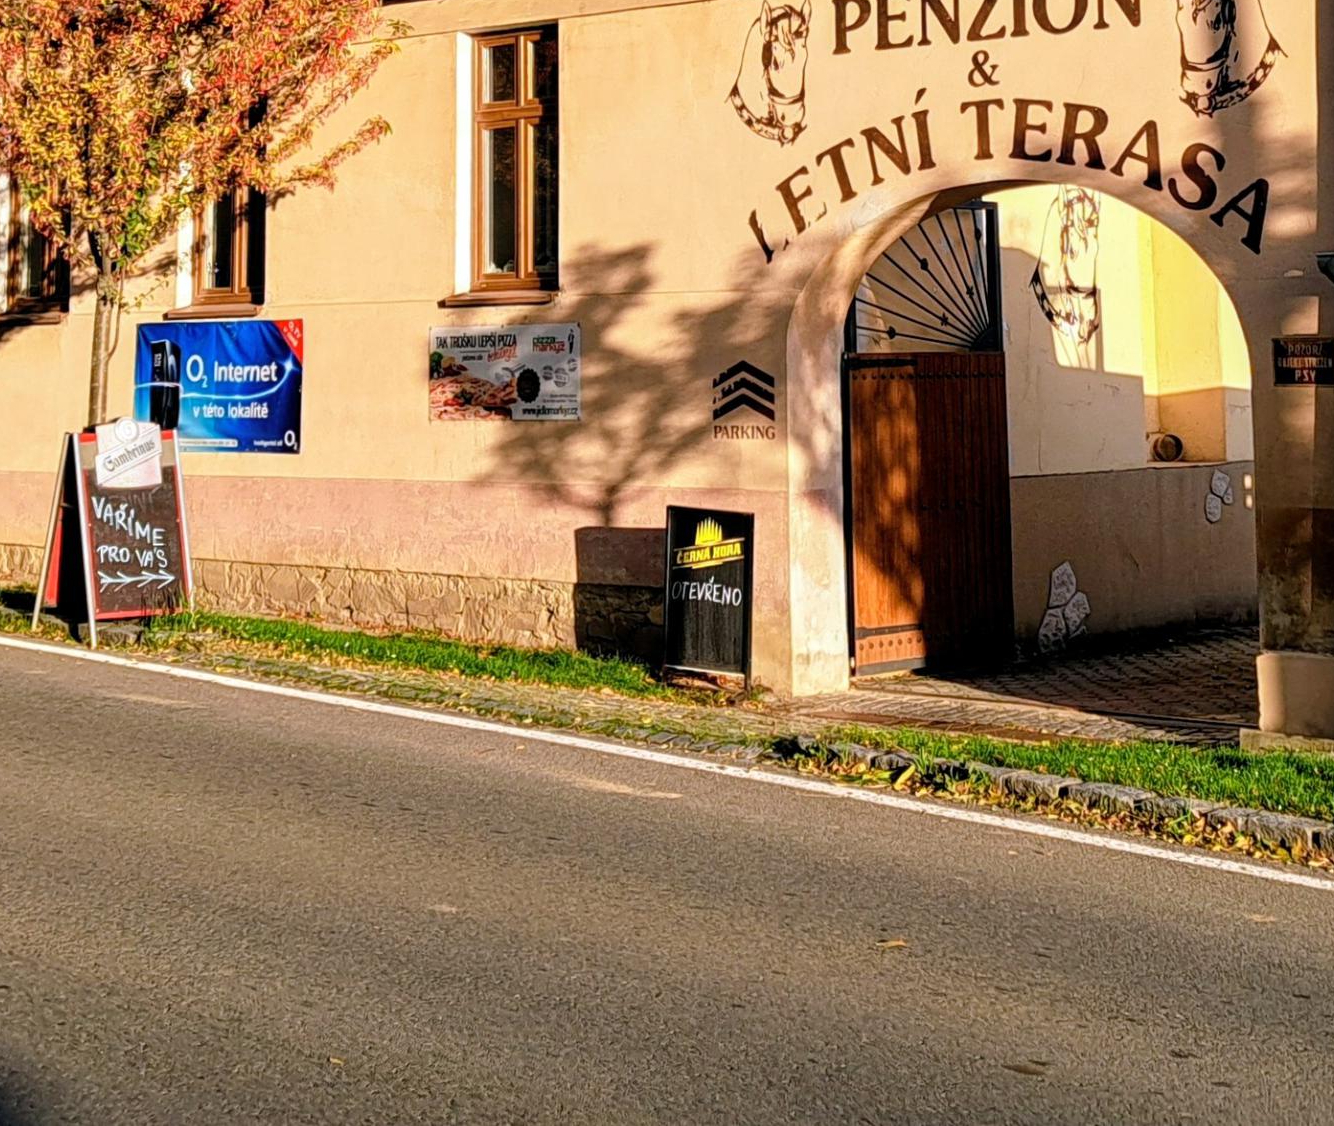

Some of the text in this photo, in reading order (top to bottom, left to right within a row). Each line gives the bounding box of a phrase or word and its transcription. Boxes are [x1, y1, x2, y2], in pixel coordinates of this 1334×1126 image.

[967, 49, 1000, 87] &
[747, 88, 1269, 264] LETNÍ TERASA
[498, 333, 517, 347] PIZZA
[214, 360, 278, 382] Internet
[1295, 369, 1316, 382] PSY
[193, 408, 200, 418] v
[203, 402, 225, 418] této
[713, 425, 776, 440] PARKING
[103, 439, 155, 472] Gambrinus
[91, 495, 166, 547] VAŘÍME
[97, 545, 130, 564] PRO
[712, 542, 742, 558] HORA
[672, 576, 742, 606] OTEVŘENO
